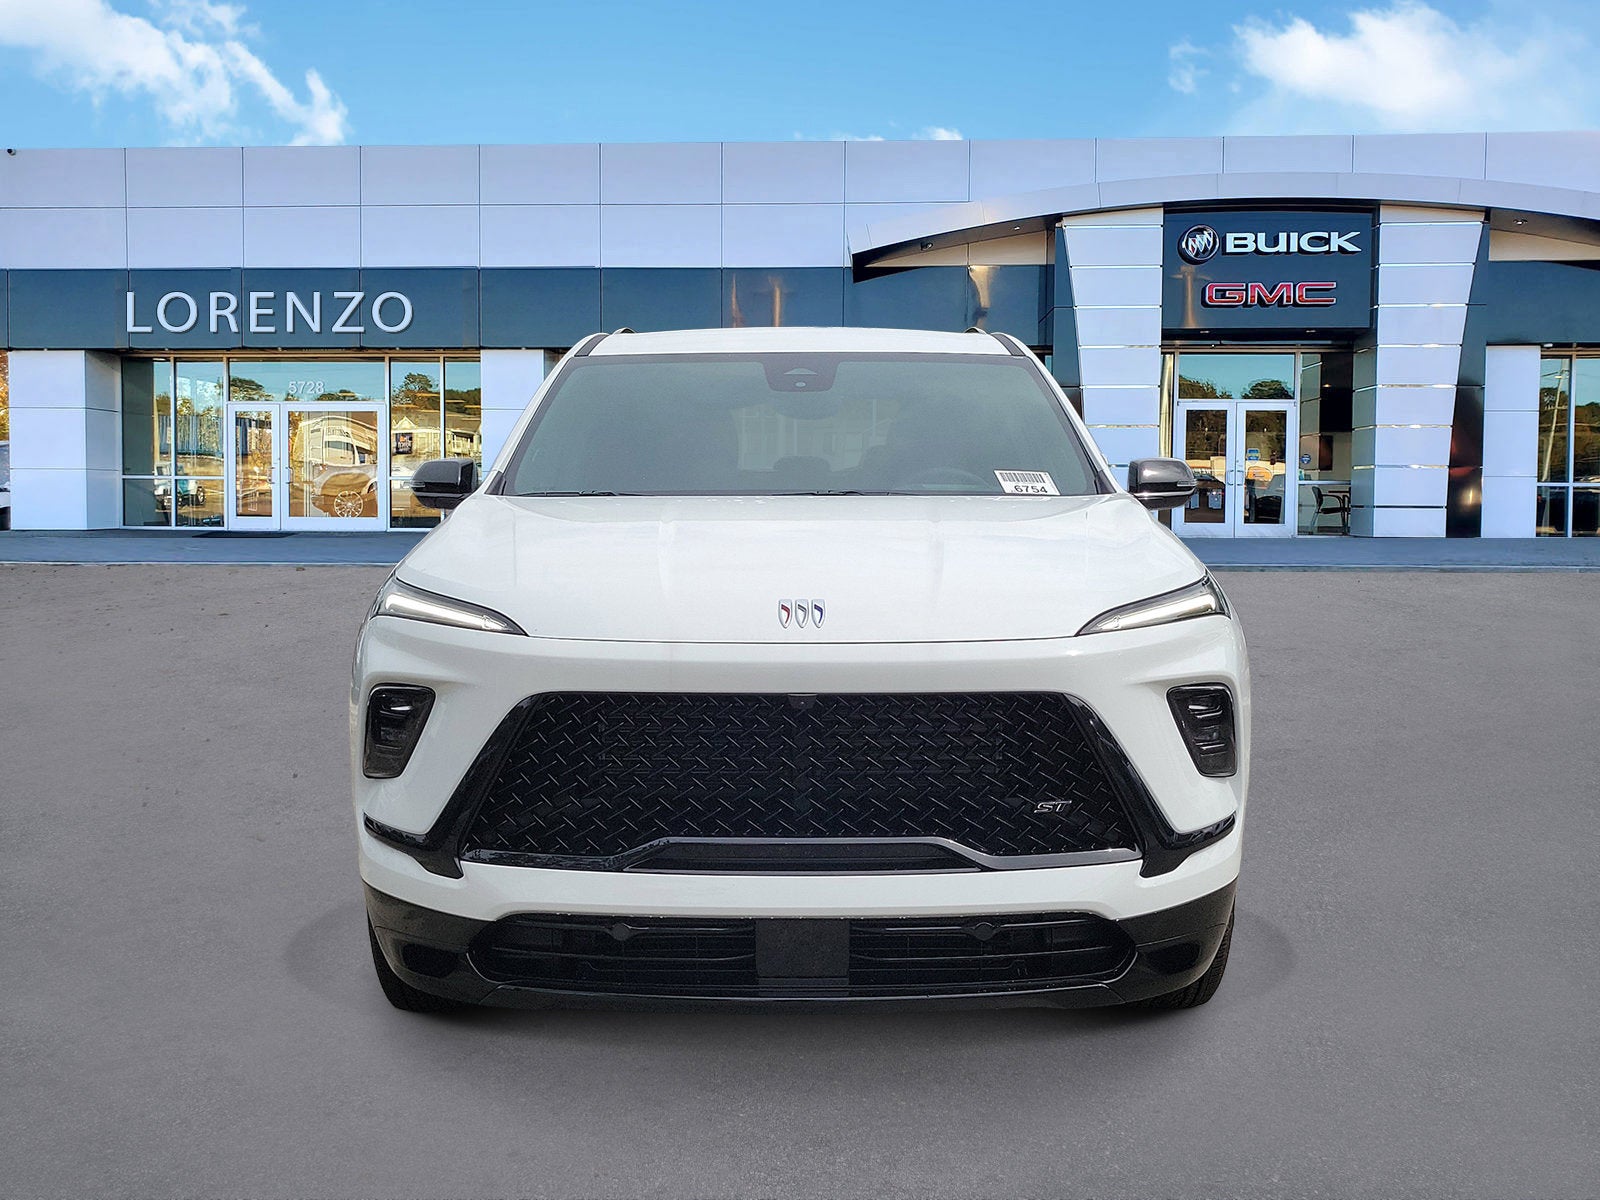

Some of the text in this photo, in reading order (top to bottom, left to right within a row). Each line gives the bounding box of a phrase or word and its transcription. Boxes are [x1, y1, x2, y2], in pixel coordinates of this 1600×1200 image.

[1224, 231, 1362, 254] BUICK
[1203, 281, 1337, 306] GMC
[126, 291, 414, 334] LORENZO
[288, 380, 325, 395] 5728
[1014, 484, 1048, 494] 6754
[1033, 800, 1072, 813] ST
